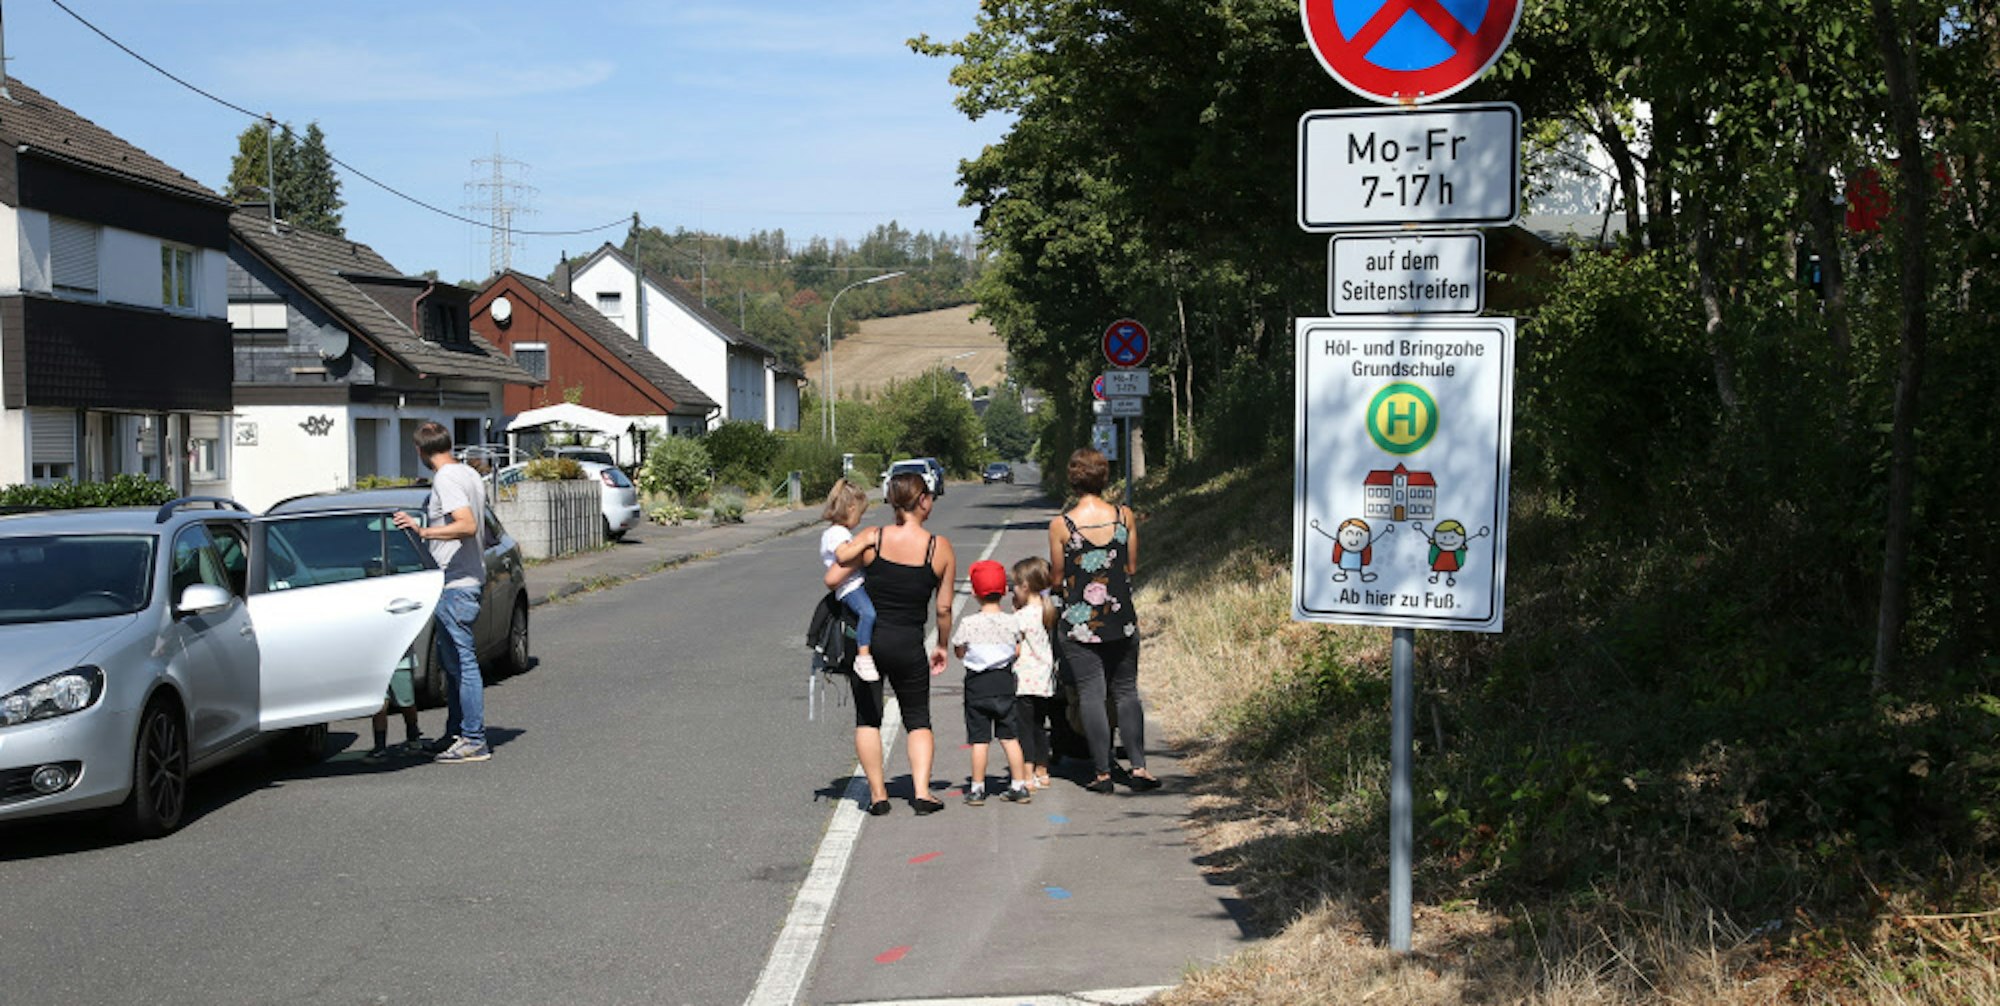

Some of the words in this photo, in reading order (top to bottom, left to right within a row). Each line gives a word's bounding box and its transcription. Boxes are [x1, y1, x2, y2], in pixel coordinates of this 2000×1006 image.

[1348, 129, 1467, 164] Mo-Fr
[1366, 250, 1394, 271] auf
[1401, 250, 1439, 271] dem
[1341, 280, 1470, 301] Seitenstreifen
[1363, 340, 1394, 356] und
[1351, 360, 1455, 377] Grundschule
[1387, 402, 1416, 436] H
[1365, 589, 1396, 606] hier
[1400, 595, 1419, 607] zu
